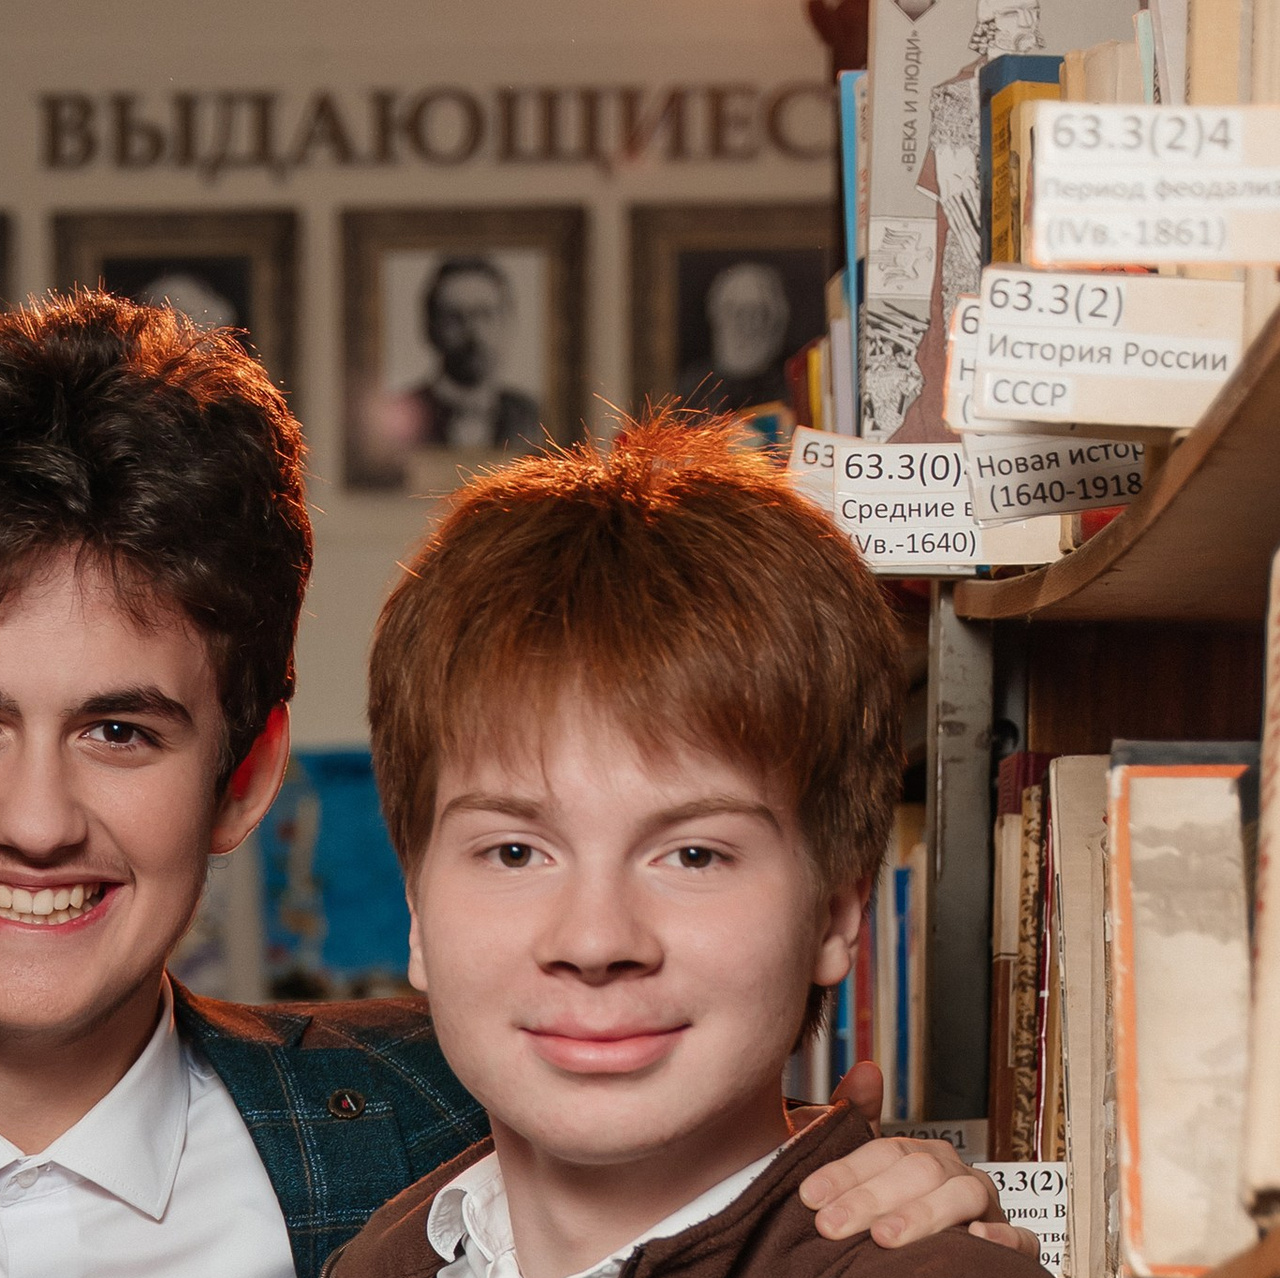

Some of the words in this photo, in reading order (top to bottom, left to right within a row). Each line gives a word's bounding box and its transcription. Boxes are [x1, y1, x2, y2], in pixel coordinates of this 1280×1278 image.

[904, 31, 922, 94] ЛЮДИ»
[905, 100, 918, 113] И
[38, 84, 837, 178] ВЫДАЮЩИЕС
[902, 118, 918, 172] «ВЕКА
[1052, 113, 1233, 158] 63.3(2)4
[1154, 176, 1280, 201] феодали
[990, 278, 1124, 326] 63.3(2)
[988, 334, 1112, 367] История
[1123, 342, 1228, 371] России
[992, 379, 1067, 406] СССР
[845, 452, 968, 487] 63.3(0)
[977, 449, 1061, 478] Новая
[990, 472, 1144, 513] (1640-1918
[842, 499, 955, 524] Средние
[986, 1170, 1069, 1196] 3.3(2)
[1003, 1206, 1048, 1220] риод
